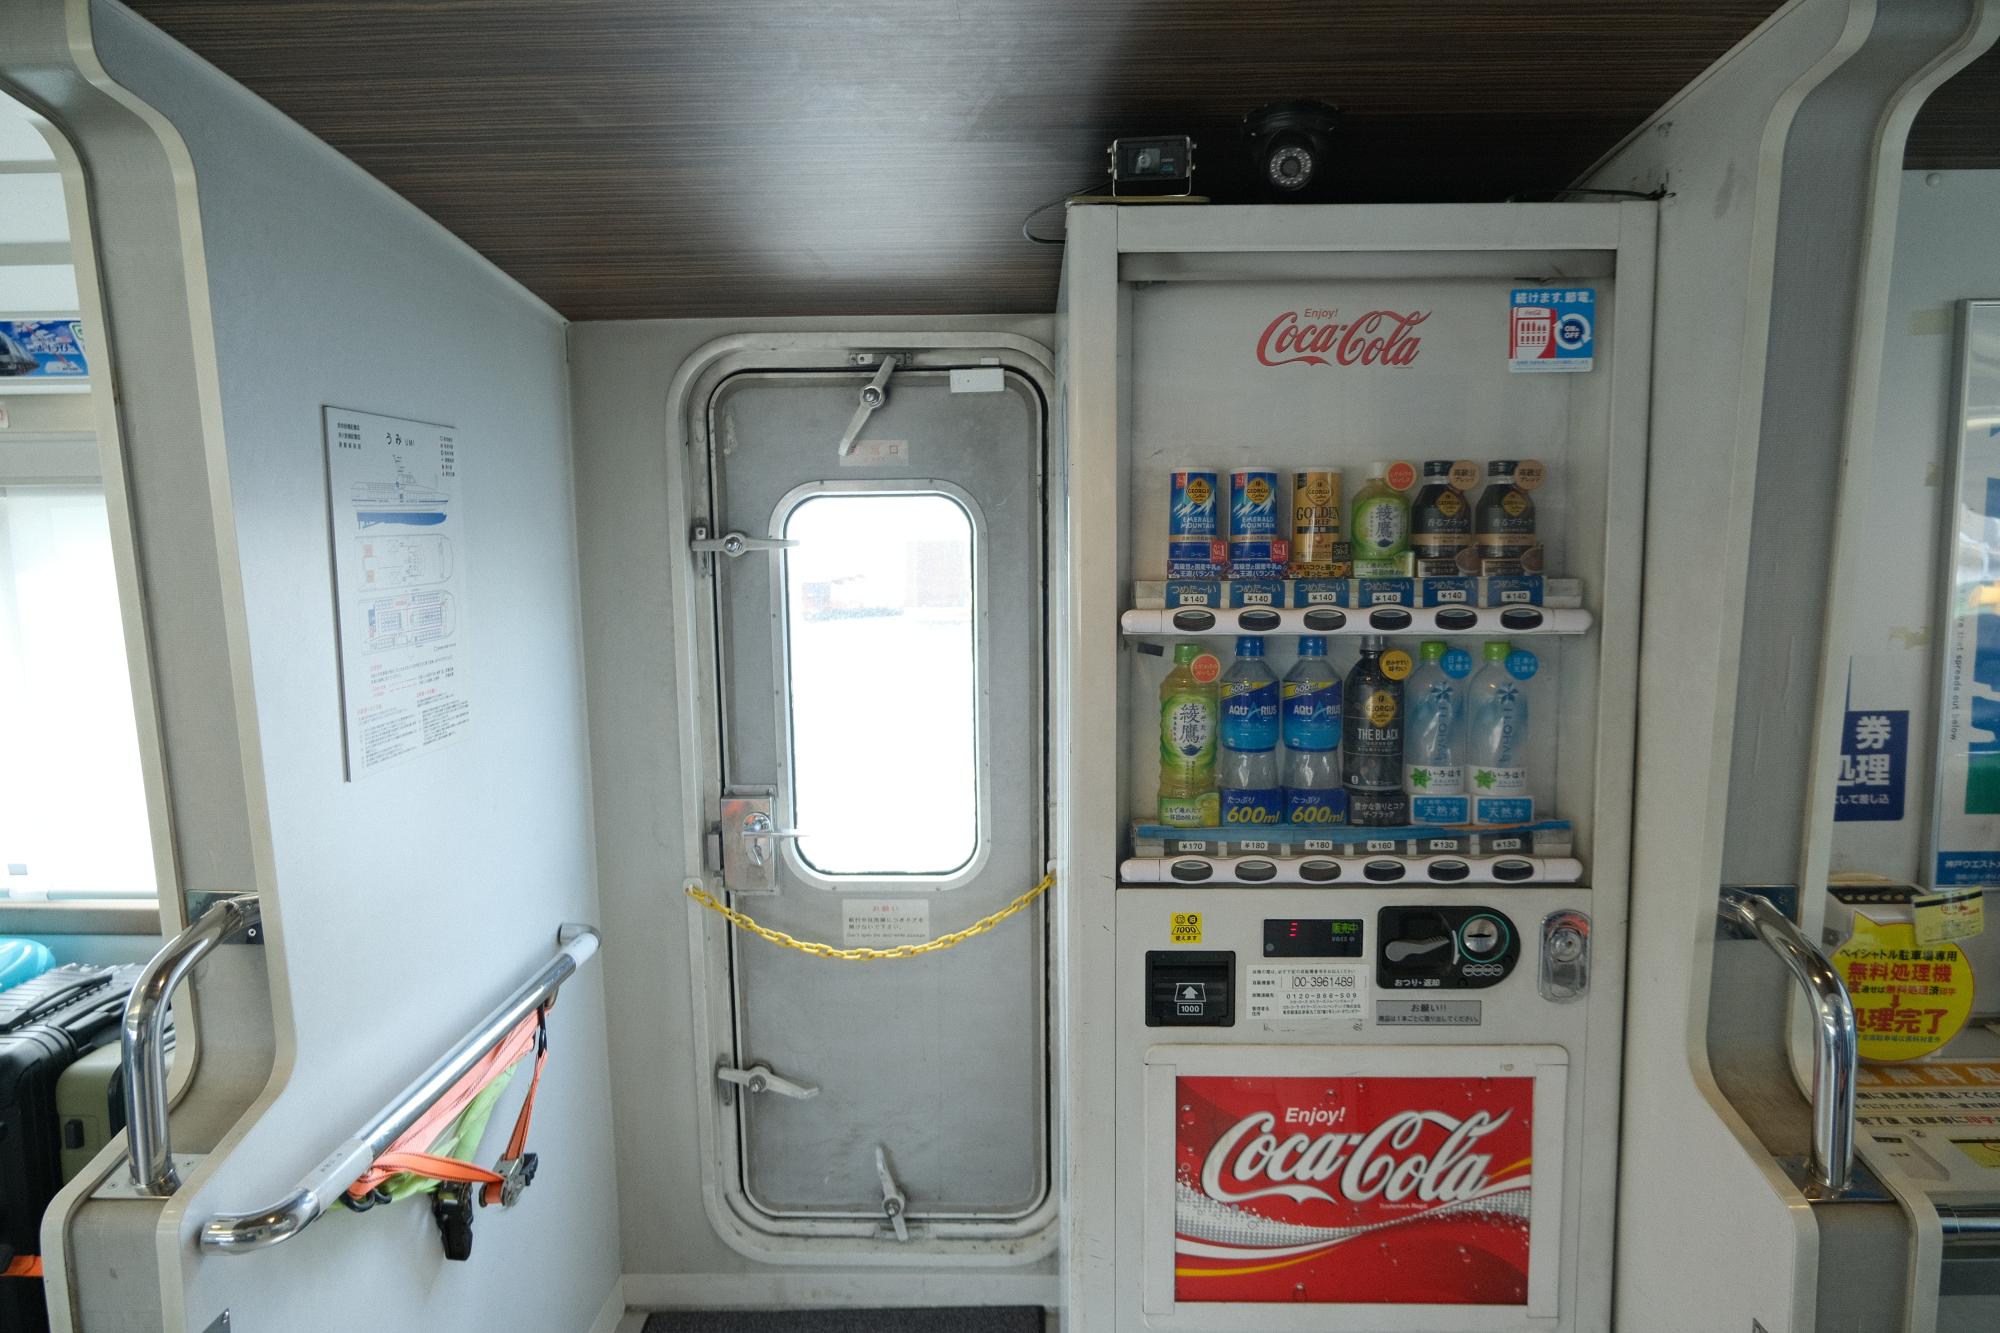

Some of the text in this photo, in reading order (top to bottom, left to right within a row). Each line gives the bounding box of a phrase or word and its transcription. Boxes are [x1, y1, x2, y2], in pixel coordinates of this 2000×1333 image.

[1304, 308, 1338, 320] Enjoy!
[1256, 309, 1432, 367] Coca-Cola
[1296, 506, 1342, 521] GOLDEN
[1375, 504, 1393, 539] 綾鷹
[1183, 595, 1205, 603] ¥140
[1247, 595, 1268, 603] ¥140
[1312, 593, 1333, 601] ¥140
[1375, 594, 1398, 602] ¥140
[1506, 592, 1527, 600] ¥140
[1953, 654, 1963, 691] spreads
[1952, 694, 1960, 710] out
[1228, 702, 1277, 719] AQUARIUS
[1293, 701, 1341, 719] AQUARIUS
[1179, 703, 1200, 744] 綾鷹
[1357, 728, 1399, 740] THE BLACK
[1856, 715, 1892, 749] 券
[1228, 796, 1255, 804] たっぷり
[1291, 796, 1320, 804] たっぷり
[1227, 806, 1280, 824] 600ml
[1291, 806, 1344, 824] 600ml
[1425, 805, 1460, 817] 天然水
[1488, 806, 1525, 818] 天然水
[1433, 841, 1454, 849] ¥130
[1495, 840, 1517, 848] ¥130
[1176, 926, 1197, 934] 1000
[1848, 961, 1952, 983] 無料処理機
[1294, 976, 1353, 987] 00-3961489
[1394, 978, 1440, 987] おつり・返却
[1181, 1005, 1200, 1013] 1000
[1284, 1106, 1346, 1127] Enjoy!
[1201, 1107, 1514, 1205] Coca-Cola
